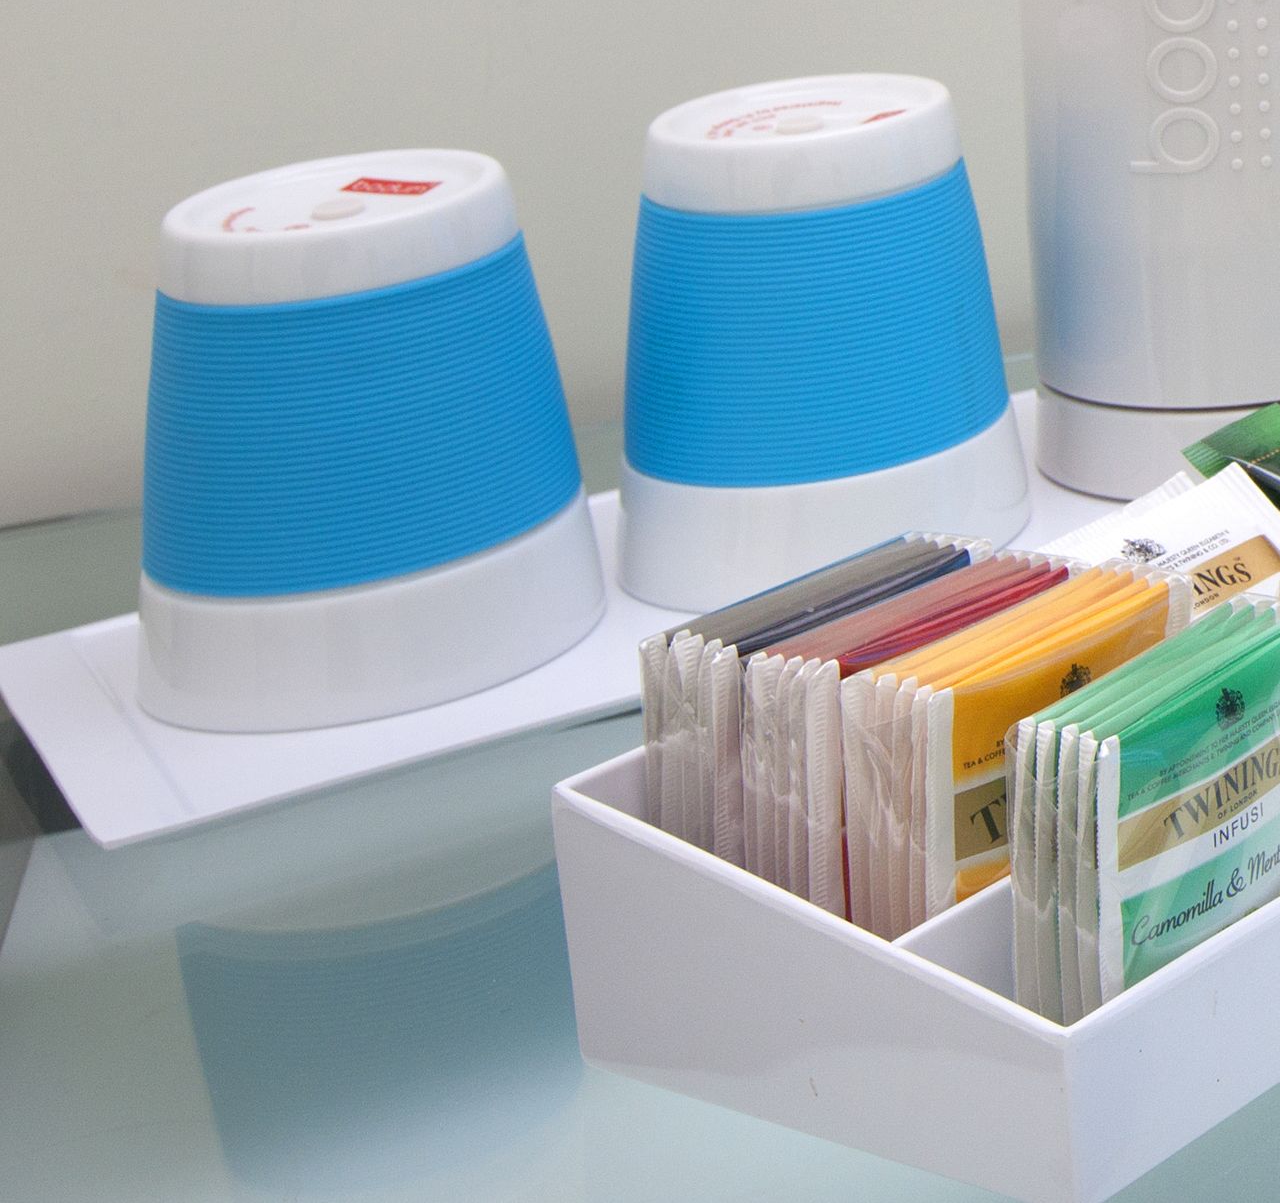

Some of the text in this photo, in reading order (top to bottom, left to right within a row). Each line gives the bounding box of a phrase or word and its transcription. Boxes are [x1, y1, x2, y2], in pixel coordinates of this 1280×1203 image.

[1193, 562, 1252, 596] INGS
[1193, 593, 1220, 610] ONDON
[963, 761, 976, 770] TEA
[1217, 790, 1258, 820] OF LONDON
[1212, 802, 1264, 848] INFUSI
[1131, 879, 1224, 946] Camomilla
[1226, 867, 1247, 898] &
